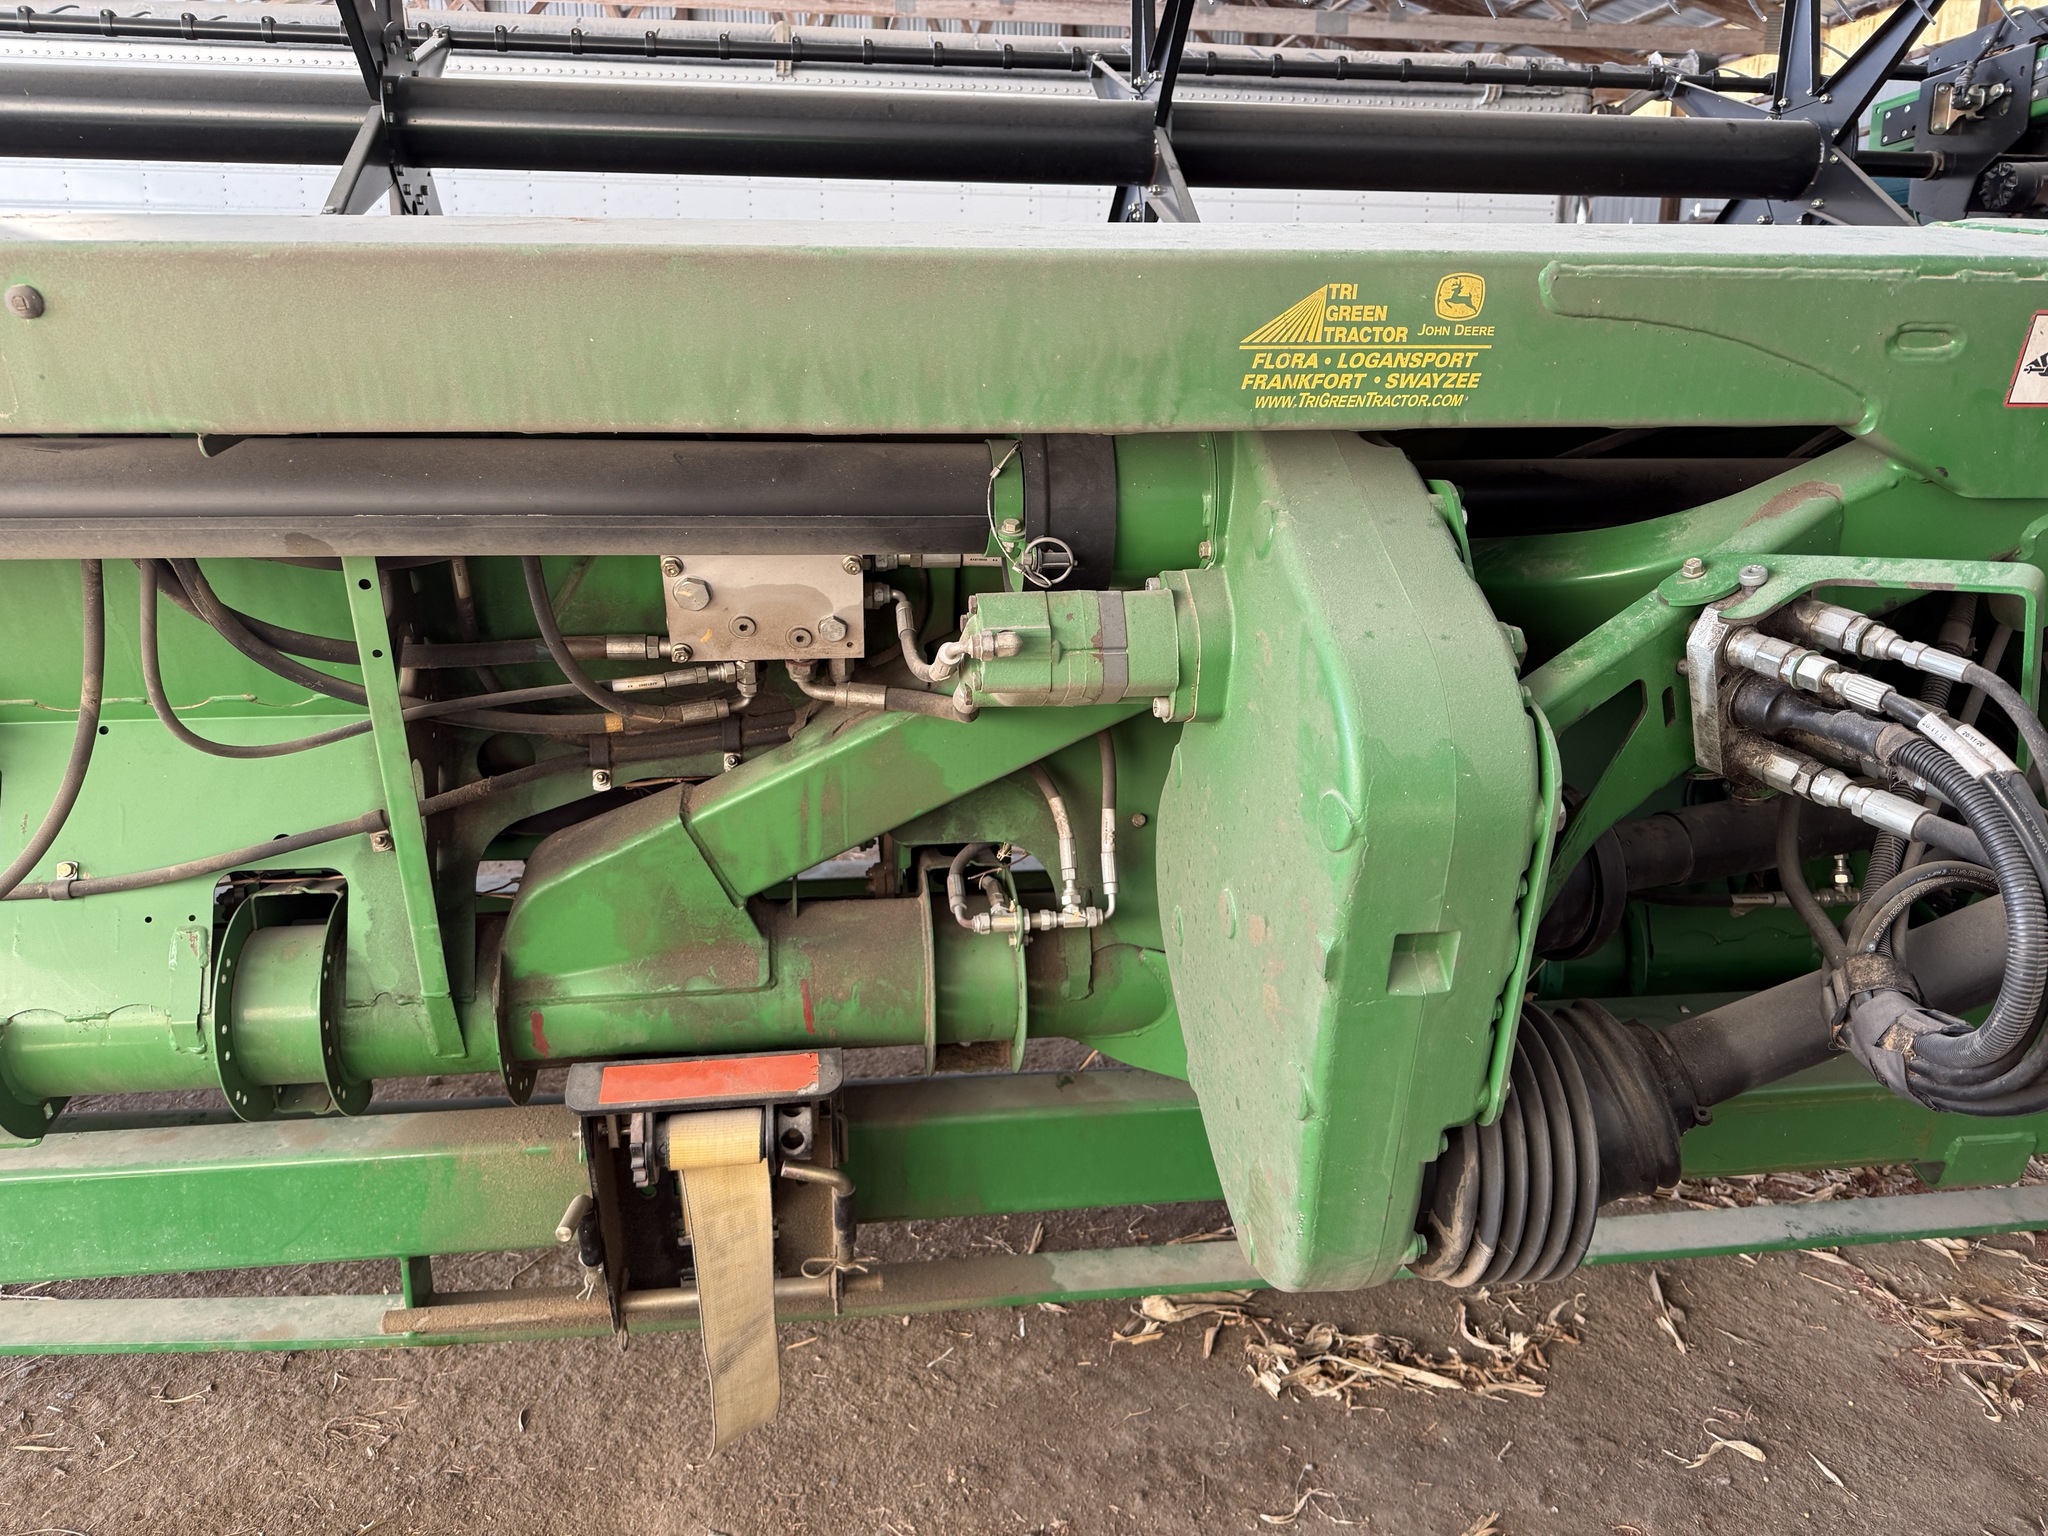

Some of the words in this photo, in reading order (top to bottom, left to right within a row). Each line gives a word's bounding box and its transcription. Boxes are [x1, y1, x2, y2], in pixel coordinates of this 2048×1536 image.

[1329, 283, 1358, 300] TRI
[1326, 305, 1388, 321] GREEN
[1324, 326, 1408, 343] TRACTOR
[1252, 353, 1318, 369] FLORA
[1337, 352, 1479, 369] LOGANSPORT
[1241, 373, 1367, 390] FRANKFORT
[1385, 373, 1482, 389] SWAYZEE
